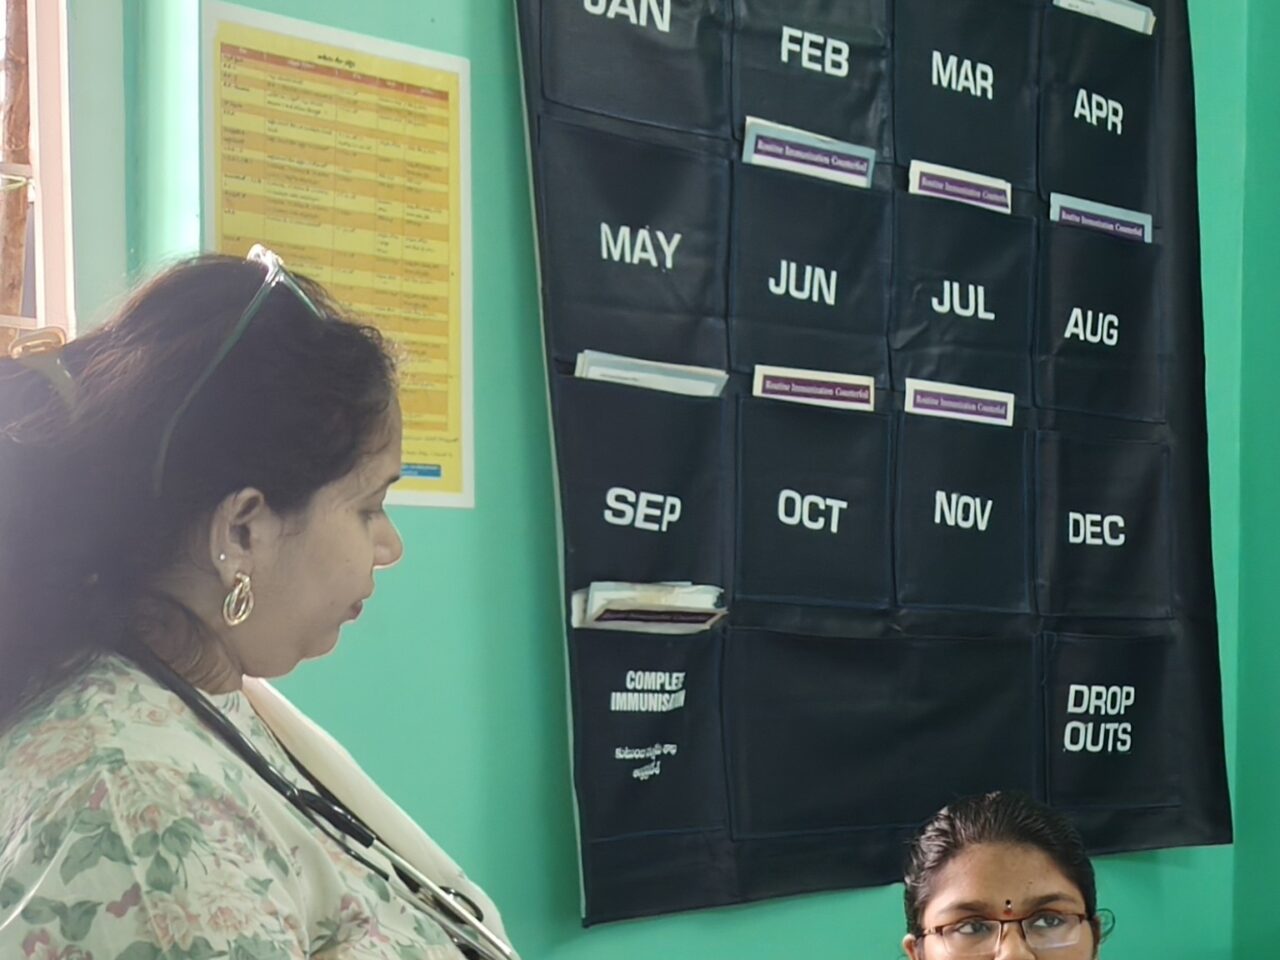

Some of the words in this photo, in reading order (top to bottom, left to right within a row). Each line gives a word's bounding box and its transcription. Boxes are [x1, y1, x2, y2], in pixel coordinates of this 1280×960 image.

[780, 25, 850, 78] FEB
[931, 50, 994, 99] MAR
[1073, 88, 1124, 135] APR
[600, 222, 682, 270] MAY
[768, 260, 838, 306] JUN
[931, 280, 996, 322] JUL
[1064, 307, 1120, 347] AUG
[603, 486, 682, 533] SEP
[777, 489, 849, 534] OCT
[933, 490, 994, 532] NOV
[1067, 511, 1126, 547] DEC
[1066, 683, 1136, 716] DROP
[1063, 720, 1133, 754] OUTS
